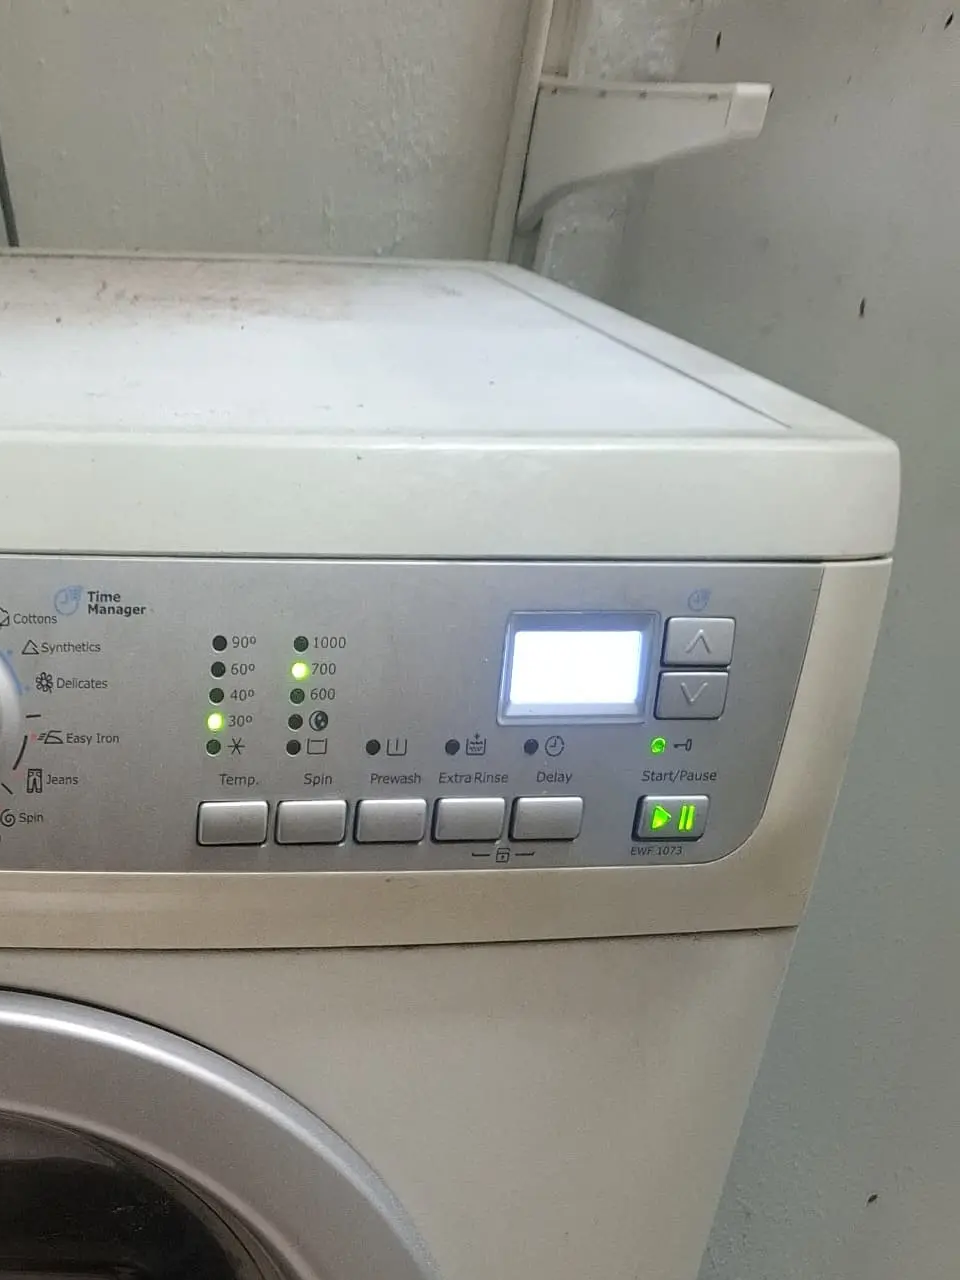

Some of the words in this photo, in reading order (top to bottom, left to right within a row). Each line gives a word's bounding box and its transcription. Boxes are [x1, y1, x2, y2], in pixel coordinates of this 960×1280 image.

[88, 591, 121, 603] Time
[88, 604, 146, 617] Manager
[13, 613, 57, 625] Cottons
[41, 641, 101, 655] Synthetics
[313, 636, 346, 649] 1000
[312, 663, 336, 675] 700
[56, 677, 108, 690] Delicates
[310, 689, 336, 700] 600
[66, 733, 93, 745] Easy
[97, 733, 120, 744] Iron
[47, 774, 78, 786] Jeans
[220, 774, 259, 787] Temp.
[304, 774, 332, 787] Spin
[370, 773, 421, 785] Prewash
[438, 772, 471, 784] Extra
[474, 772, 508, 784] Rinse
[536, 771, 572, 784] Delay
[641, 770, 717, 782] Start/Pause
[18, 812, 43, 825] Spin
[658, 846, 682, 855] 1073
